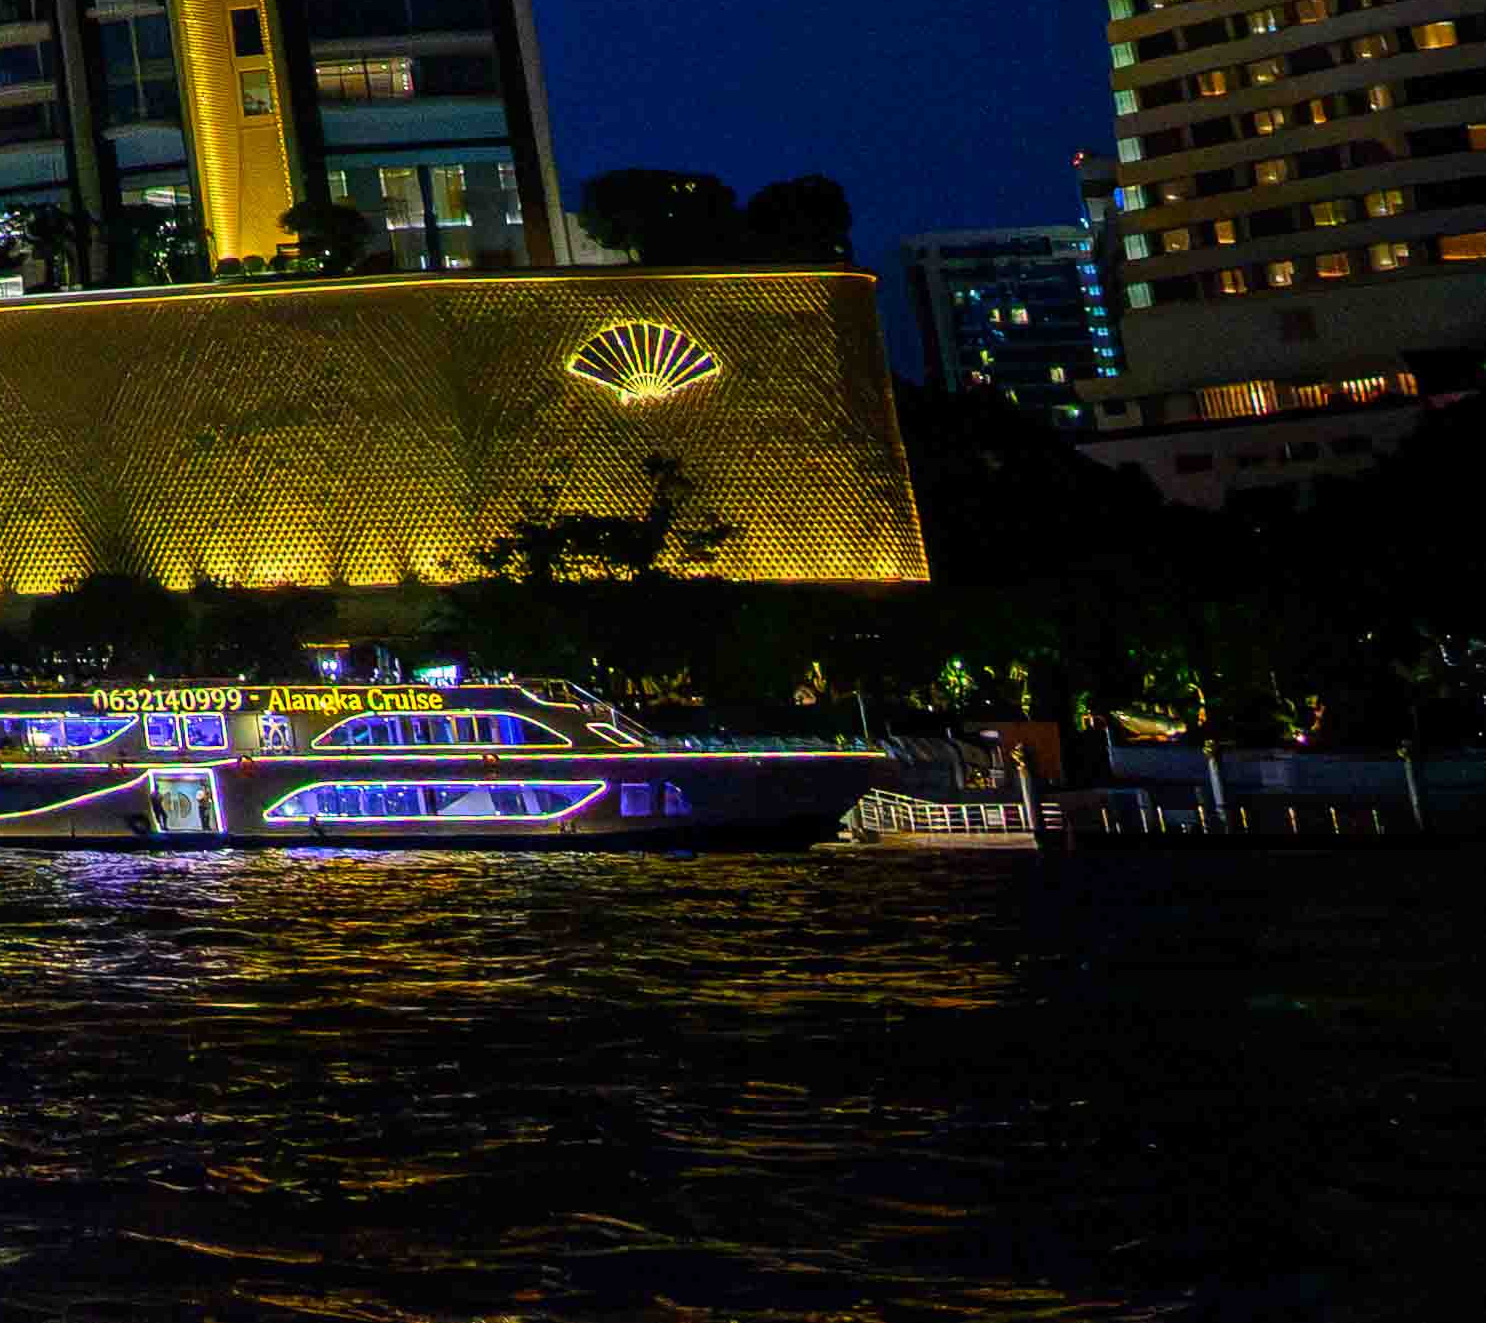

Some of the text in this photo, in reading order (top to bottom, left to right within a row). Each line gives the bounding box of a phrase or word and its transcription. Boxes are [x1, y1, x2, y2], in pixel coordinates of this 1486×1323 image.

[91, 687, 242, 713] 0632140999
[267, 686, 363, 716] Alangka
[369, 688, 444, 713] Cruise
